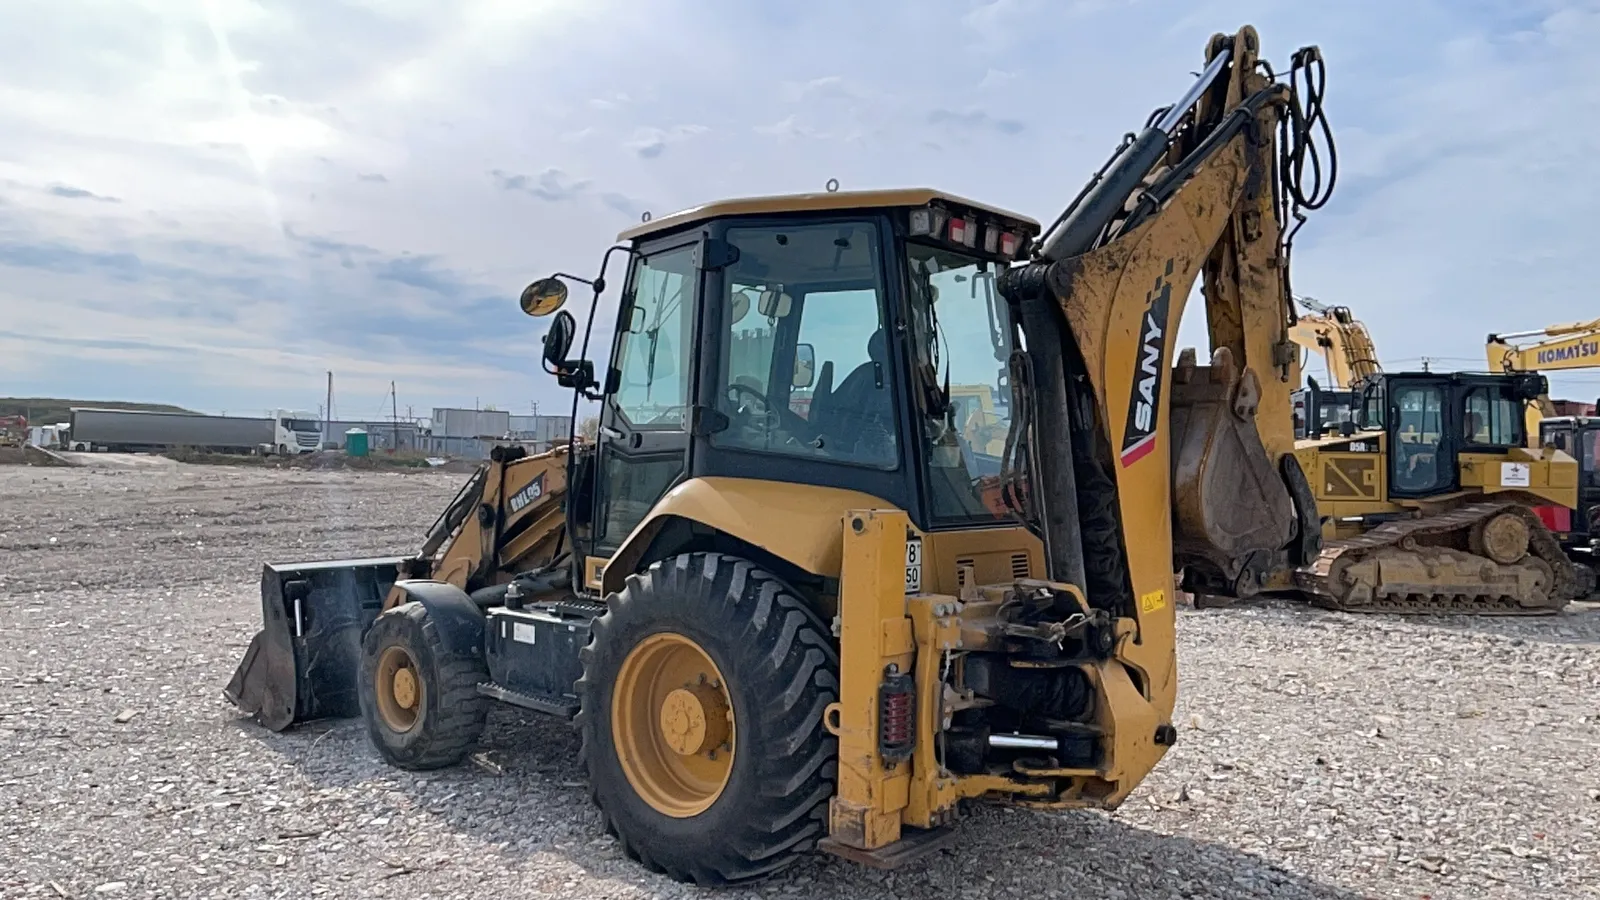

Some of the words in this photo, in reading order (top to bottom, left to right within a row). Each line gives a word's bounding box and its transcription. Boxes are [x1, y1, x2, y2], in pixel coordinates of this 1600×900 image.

[1537, 341, 1599, 364] KOMATSU
[1134, 312, 1162, 433] SANY
[906, 567, 918, 583] 50
